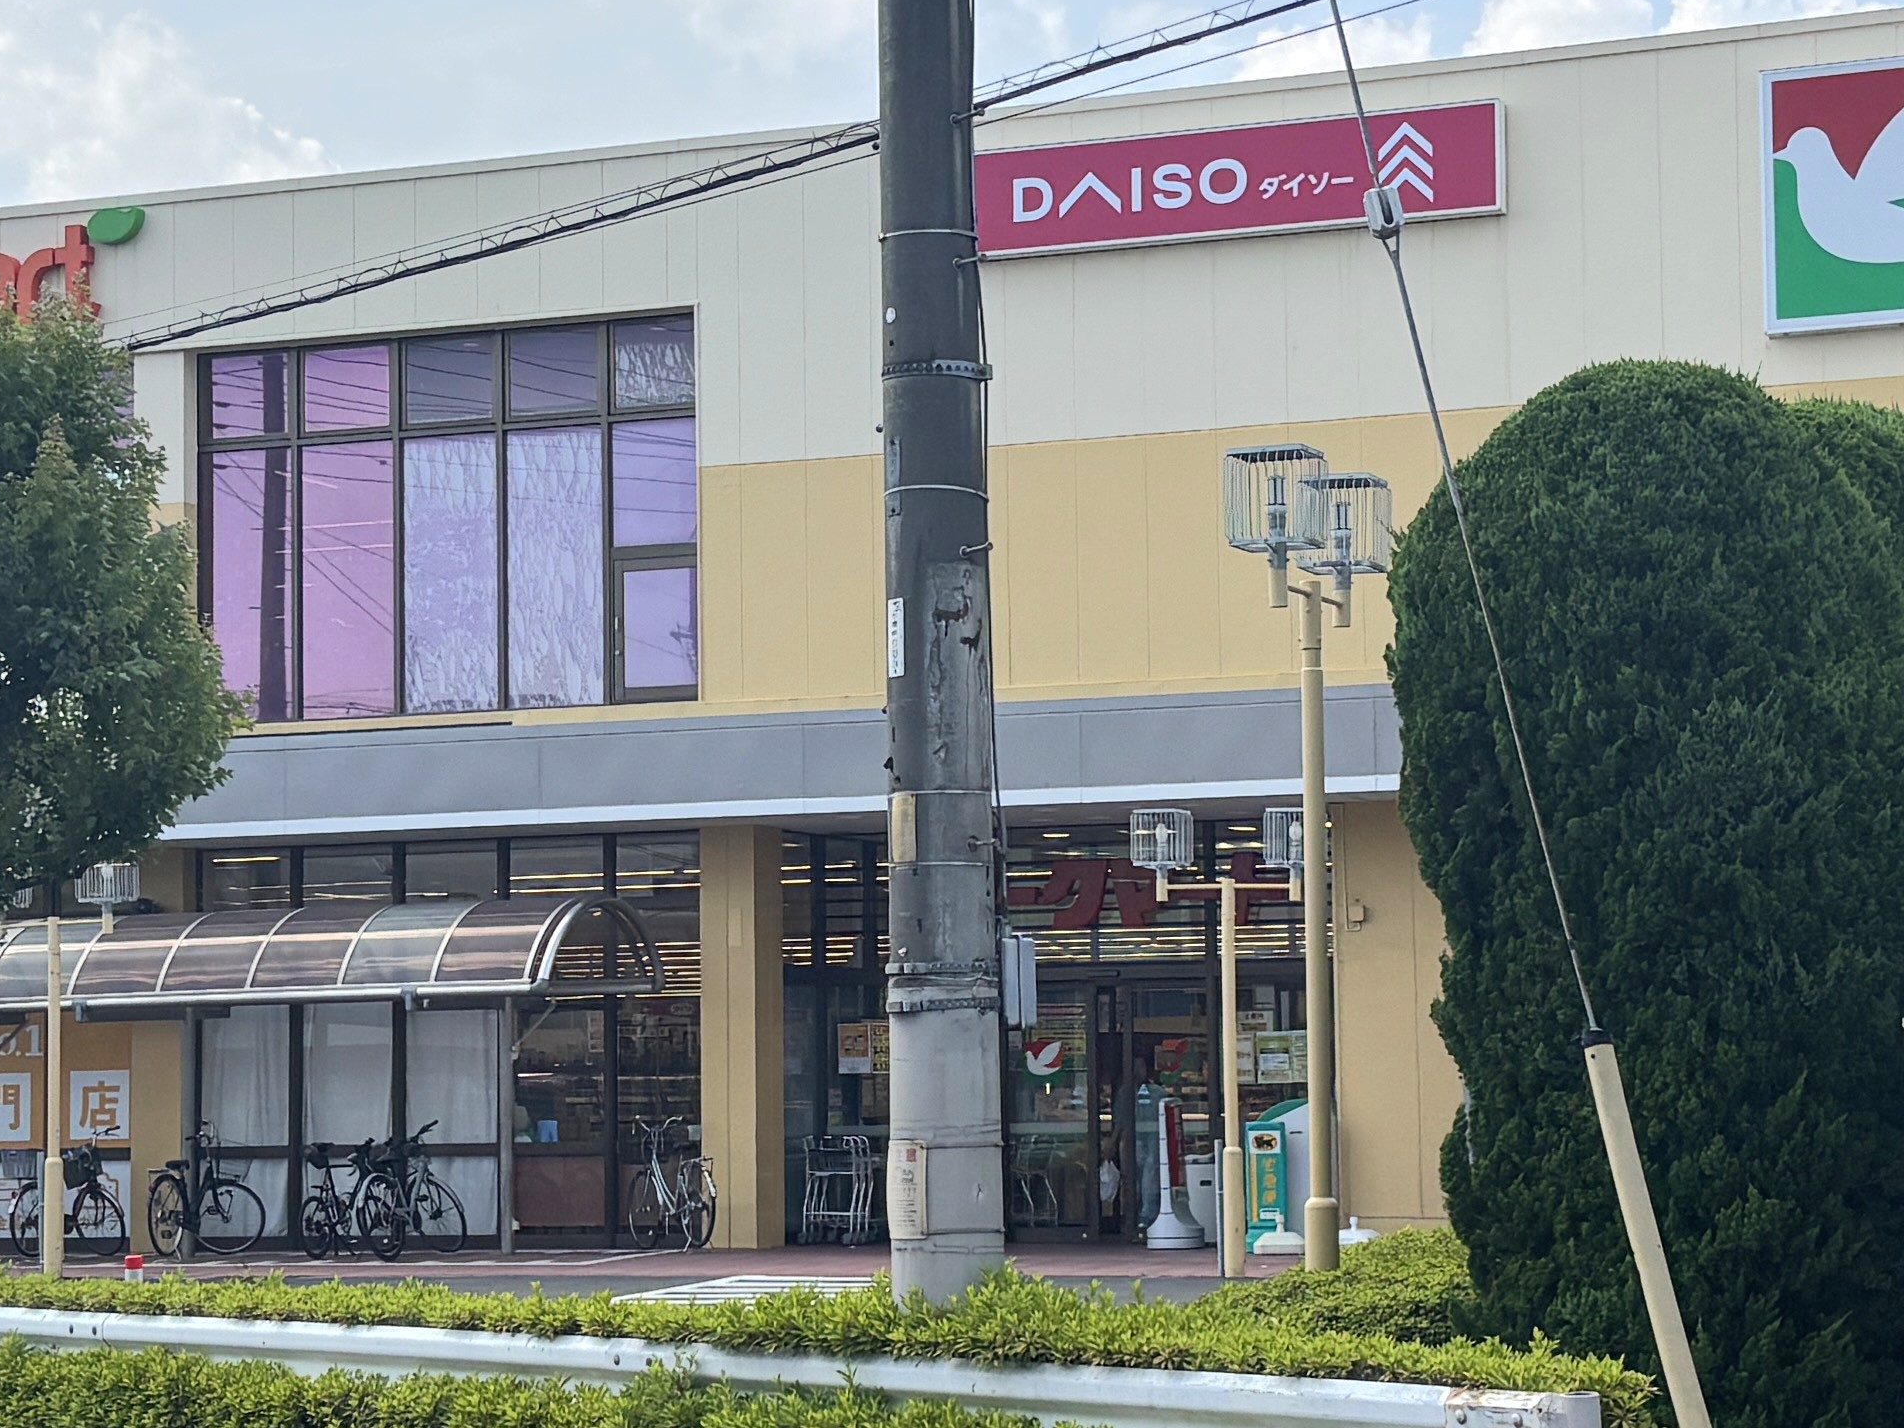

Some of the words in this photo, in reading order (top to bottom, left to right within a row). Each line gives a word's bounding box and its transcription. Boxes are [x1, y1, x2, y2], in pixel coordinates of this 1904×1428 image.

[1012, 158, 1247, 223] DAISO
[1258, 171, 1354, 200] ダイソー
